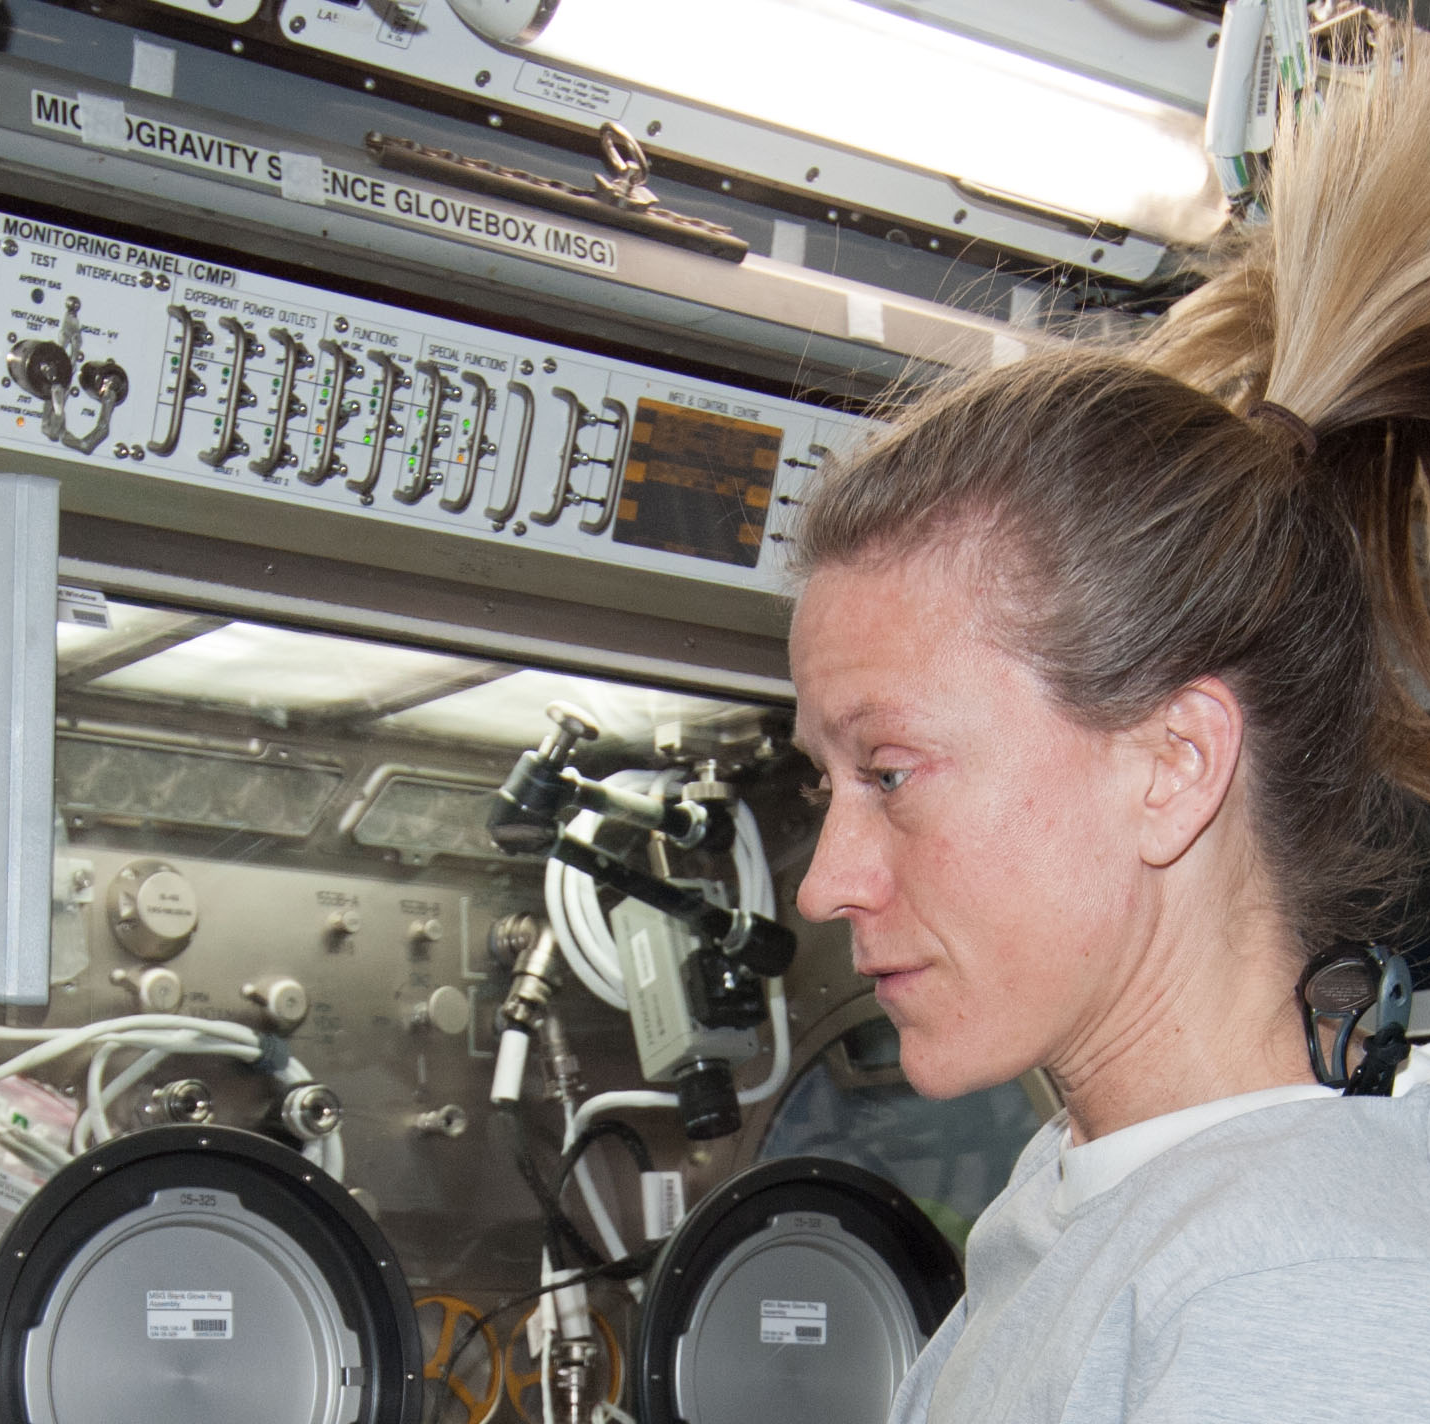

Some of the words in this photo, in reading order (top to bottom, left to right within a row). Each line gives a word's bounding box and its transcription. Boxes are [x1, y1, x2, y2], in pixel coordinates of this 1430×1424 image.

[36, 95, 258, 174] MICGRAVITY
[268, 154, 385, 208] SNCE
[395, 188, 537, 248] GLOVEBOX
[545, 227, 617, 268] (MSG)
[3, 217, 121, 261] MONITORING
[126, 246, 186, 276] PANEL
[187, 261, 238, 289] (CMP)
[30, 250, 59, 270] TEST
[75, 262, 139, 288] INTERFACES
[242, 300, 275, 320] POWER
[277, 311, 318, 330] OUTLETS
[351, 325, 400, 348] FUNCTIONS
[428, 343, 461, 363] SPECIAL
[463, 351, 509, 373] FUNCTIONS
